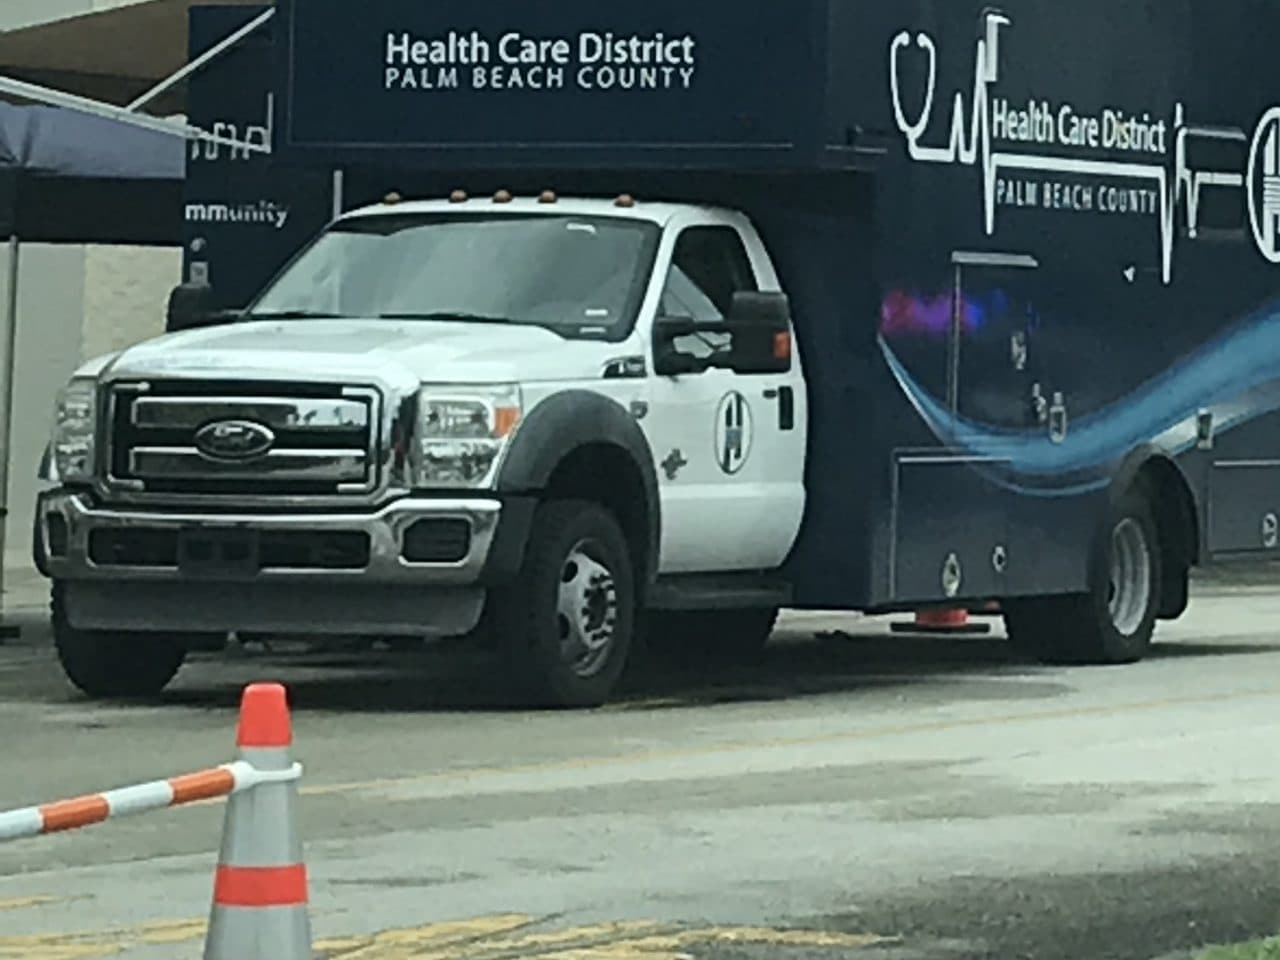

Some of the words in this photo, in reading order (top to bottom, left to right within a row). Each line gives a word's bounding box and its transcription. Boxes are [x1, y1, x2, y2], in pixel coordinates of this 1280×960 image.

[385, 31, 489, 63] Health
[498, 33, 569, 63] Care
[578, 32, 694, 63] District
[385, 68, 458, 89] PALM
[472, 67, 563, 88] BEACH
[577, 66, 694, 88] COUNTY
[992, 98, 1054, 142] Health
[1058, 104, 1099, 147] Care
[1102, 109, 1166, 153] District
[996, 178, 1037, 206] PALM
[1043, 181, 1092, 210] BEACH
[1097, 185, 1157, 214] COUNTY
